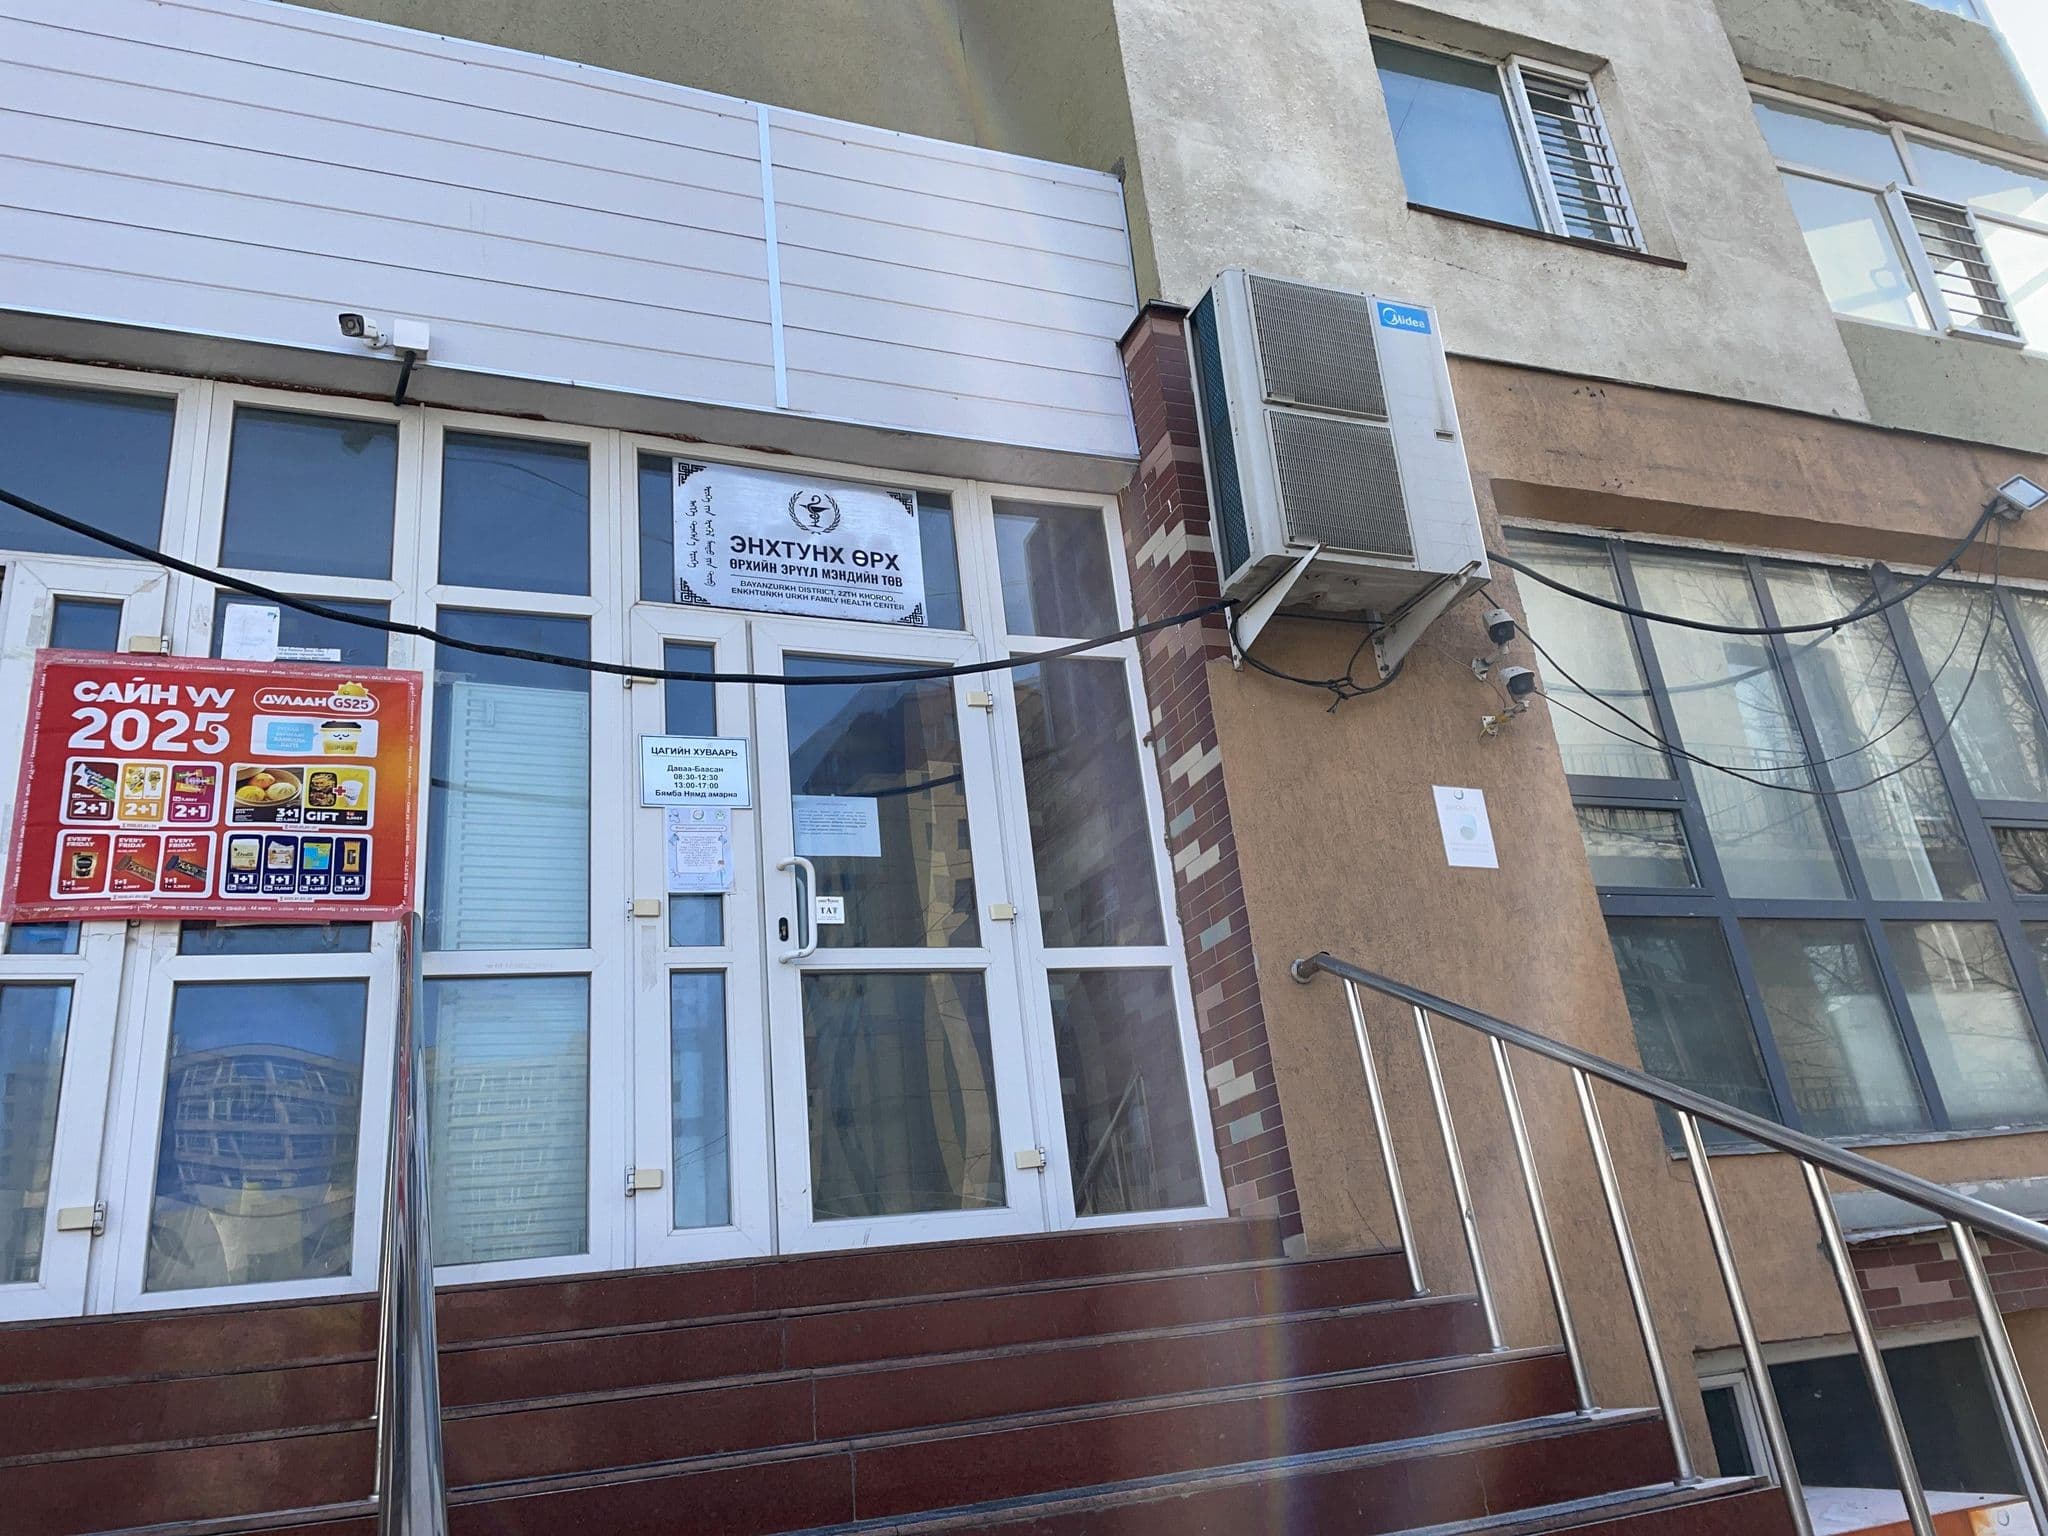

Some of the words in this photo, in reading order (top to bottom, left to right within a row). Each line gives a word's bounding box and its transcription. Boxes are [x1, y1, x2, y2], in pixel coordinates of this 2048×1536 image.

[1388, 313, 1425, 328] Midea
[730, 535, 845, 565] ЭНХТУНХ
[852, 549, 900, 571] ӨРХ
[730, 558, 777, 573] ӨРХИЙН
[781, 564, 818, 578] ЭРҮҮЛ
[822, 568, 878, 584] МЭНДИЙН
[881, 575, 903, 587] ТӨВ
[740, 580, 796, 592] BAYANZURKH
[838, 590, 857, 598] 22TH
[731, 587, 783, 599] ENKHTUNKH
[785, 593, 808, 601] URKH
[810, 595, 839, 604] FAMILY
[841, 598, 871, 607] HEALTH
[873, 602, 905, 611] CENTER
[73, 677, 179, 706] САЙН
[185, 686, 236, 709] УУ
[260, 694, 327, 707] ДУЛААН
[333, 697, 369, 710] GS25
[68, 706, 231, 754] 2025
[651, 746, 691, 756] ЦАГИЙН
[693, 748, 738, 757] ХУВААРЬ
[667, 764, 724, 772] Даваа-Баасан
[673, 773, 719, 781] 08:30-12:30
[655, 789, 682, 797] Бямба
[684, 790, 707, 798] Нямд
[73, 801, 108, 816] 2+1
[125, 803, 158, 817] 2+1
[174, 805, 208, 818] 2+1
[276, 808, 300, 818] 3+1
[306, 811, 339, 822] GIFT
[232, 873, 254, 884] 1+1
[269, 874, 290, 885] 1+1
[305, 875, 325, 885] 1+1
[339, 875, 359, 886] 1+1
